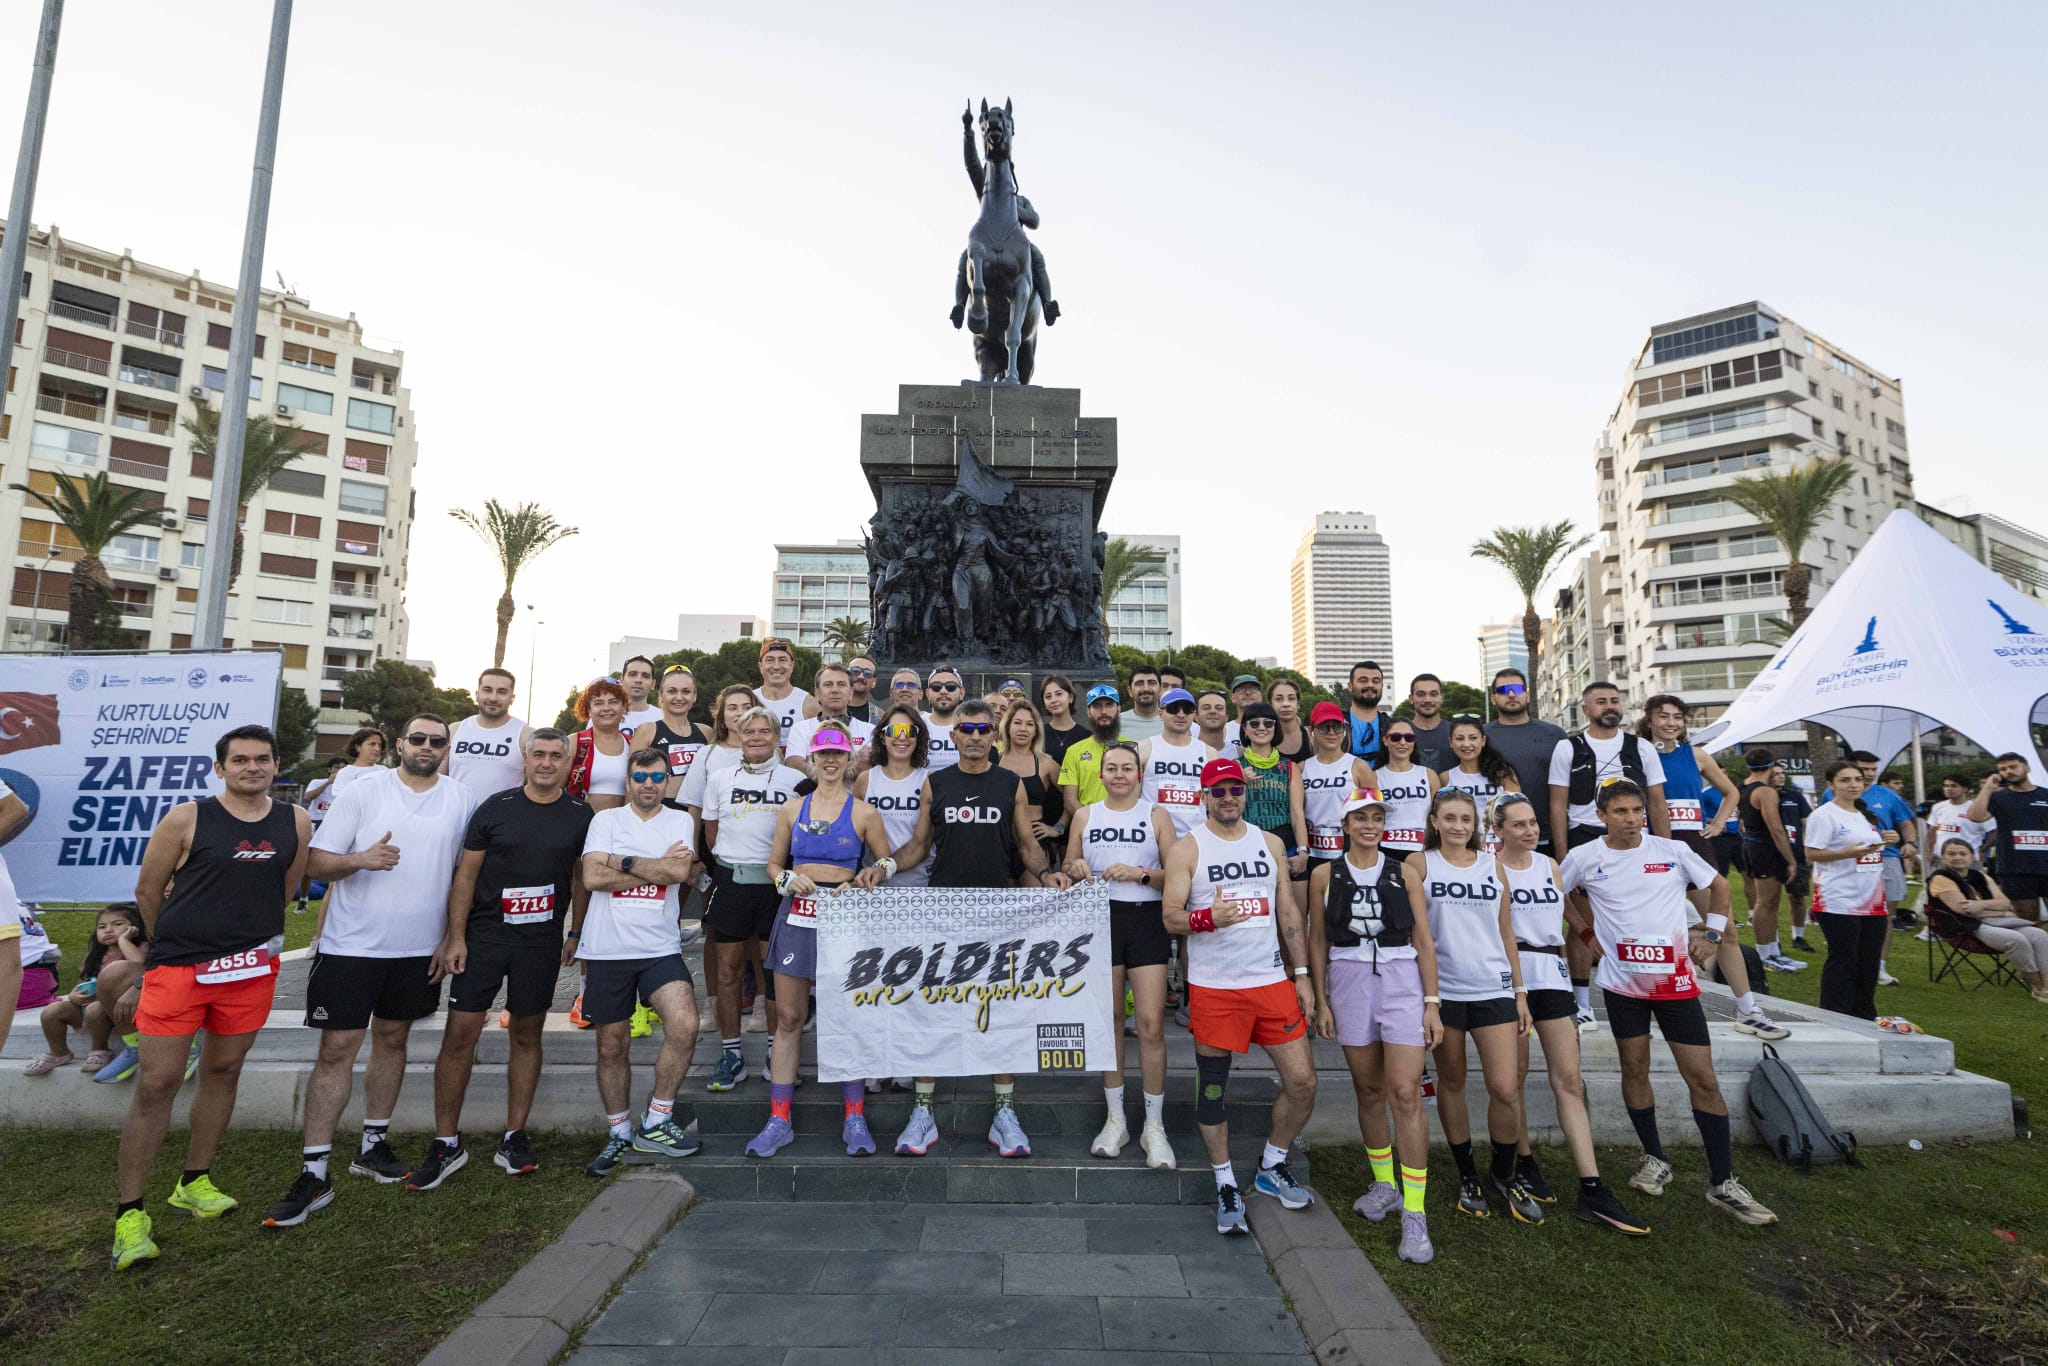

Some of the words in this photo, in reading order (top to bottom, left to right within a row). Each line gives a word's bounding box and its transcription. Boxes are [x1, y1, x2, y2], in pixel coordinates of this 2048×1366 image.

[1993, 646, 2048, 657] BÜYÜK
[1816, 659, 1909, 686] BÜYÜKŞEHİR
[96, 702, 230, 724] KURTULUŞUN
[91, 723, 191, 748] ŞEHRİNDE
[455, 741, 510, 757] BOLD
[77, 755, 213, 791] ZAFER
[1154, 761, 1204, 777] BOLD
[1303, 776, 1346, 790] BOLD
[730, 787, 788, 805] BOLD
[1164, 790, 1195, 803] 1995
[1381, 786, 1428, 801] BOLD
[867, 796, 921, 811] BOLD
[67, 795, 207, 833] SENİ
[944, 805, 1002, 824] BOLD
[1089, 827, 1146, 844] BOLD
[1387, 829, 1418, 842] 3231
[1207, 860, 1270, 883] BOLD
[1431, 881, 1497, 901] BOLD
[510, 896, 549, 913] 2714
[797, 899, 817, 915] 15
[207, 950, 258, 973] 2656
[1624, 945, 1666, 961] 1603
[840, 932, 1094, 993] BOLDERS
[1674, 975, 1692, 986] 21K
[852, 983, 914, 1007] are
[921, 950, 1086, 1033] everywhere
[1040, 1026, 1083, 1037] FORTUNE
[1039, 1039, 1069, 1048] FAVOURS
[1071, 1039, 1083, 1048] THE
[1041, 1050, 1084, 1069] BOLD
